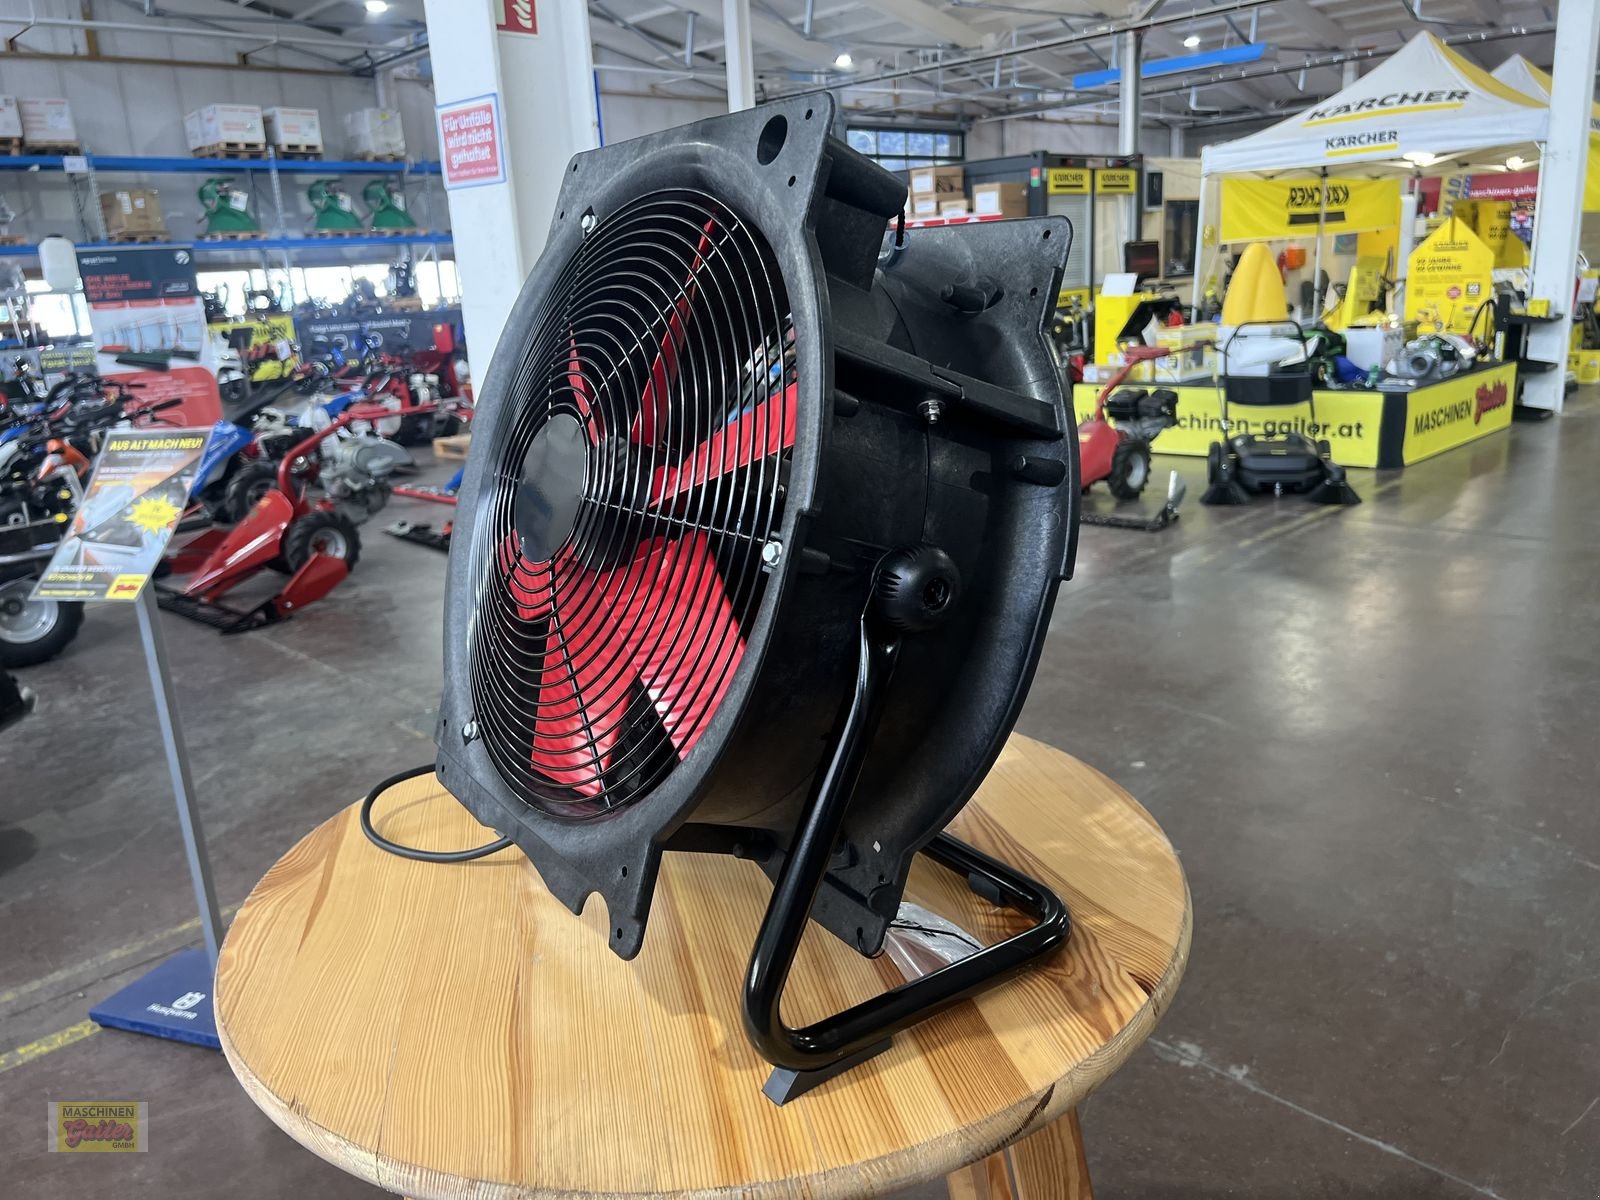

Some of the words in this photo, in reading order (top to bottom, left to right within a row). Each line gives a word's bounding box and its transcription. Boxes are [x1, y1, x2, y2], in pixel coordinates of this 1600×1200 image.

[1308, 90, 1470, 121] KÄRCHER
[442, 116, 459, 132] Für
[459, 109, 492, 129] Unfälle
[447, 131, 467, 149] wird
[467, 127, 492, 146] nicht
[1325, 130, 1398, 151] KÄRCHER
[1413, 399, 1473, 437] MASCHINEN
[109, 441, 130, 452] AUS
[130, 440, 149, 451] ALT
[149, 438, 179, 450] MACH
[178, 437, 204, 449] NEU!
